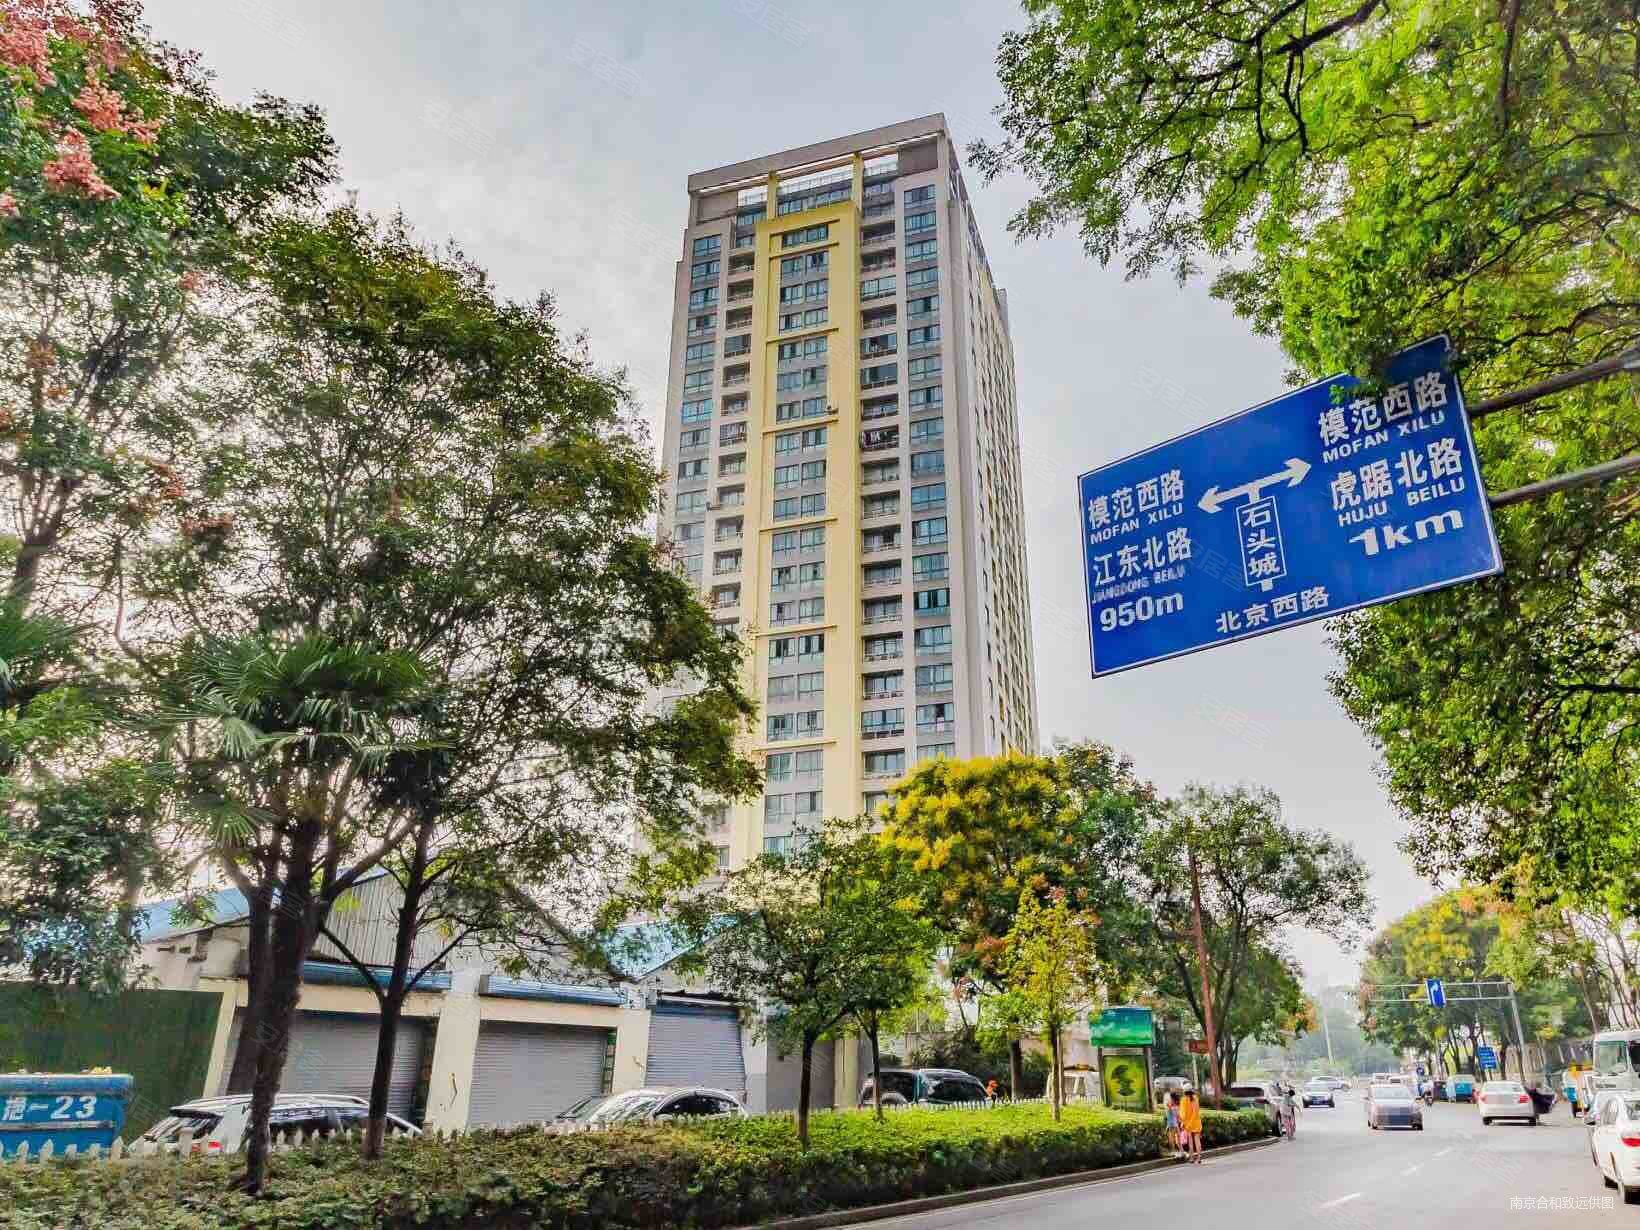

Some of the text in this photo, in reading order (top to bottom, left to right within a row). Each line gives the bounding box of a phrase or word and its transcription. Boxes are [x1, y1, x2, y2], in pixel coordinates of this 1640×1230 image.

[1318, 371, 1448, 447] 模范西路
[1322, 410, 1445, 463] MOFAN XILU
[1088, 469, 1184, 529] 模范西路
[1330, 438, 1463, 511] 虎踞北路
[1090, 503, 1183, 544] MOFAN XILU
[1338, 477, 1465, 527] HUJU BEILU
[1093, 528, 1192, 586] 江东北路
[1242, 502, 1280, 578] 石头城
[1349, 509, 1464, 556] 1km
[1101, 592, 1184, 632] 950m
[1216, 585, 1329, 633] 北京西路
